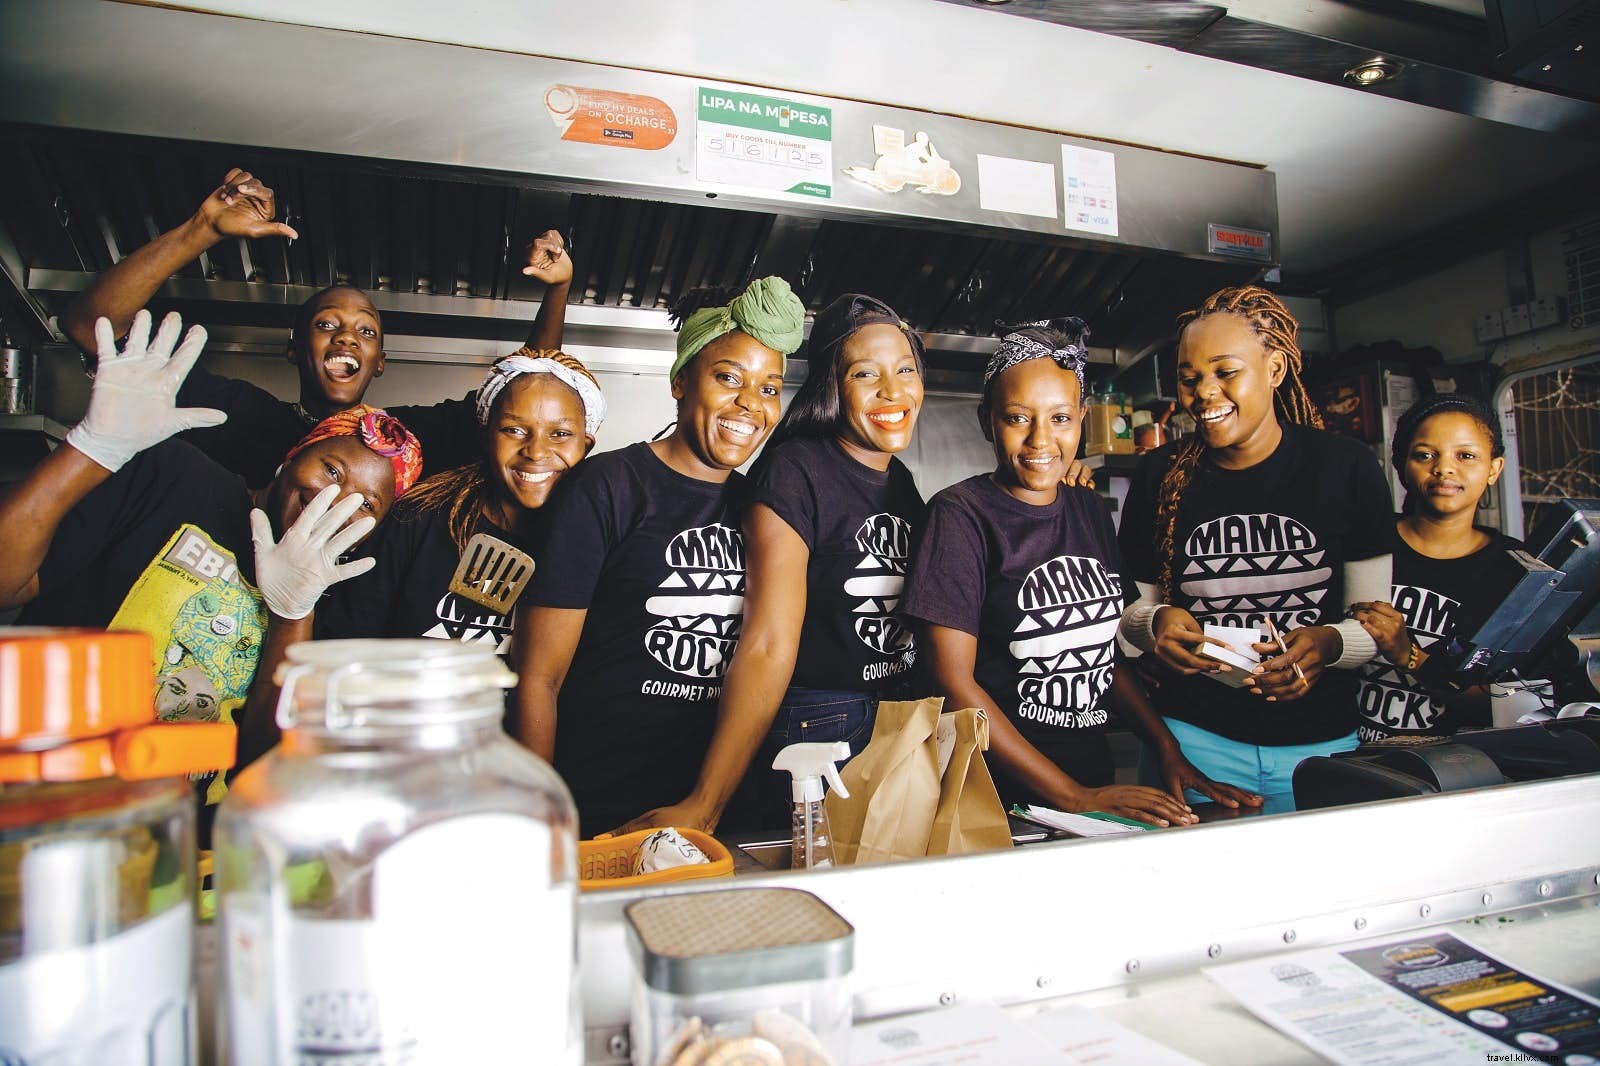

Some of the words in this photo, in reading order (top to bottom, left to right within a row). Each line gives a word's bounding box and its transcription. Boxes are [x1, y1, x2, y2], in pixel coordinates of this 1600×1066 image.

[702, 95, 736, 111] LIPA
[739, 100, 762, 115] NA
[588, 110, 602, 118] ON
[605, 113, 667, 130] OCHARGE
[740, 134, 764, 143] GOODS
[778, 140, 807, 149] NUMBER
[1190, 514, 1313, 556] MAMA
[641, 679, 705, 702] GOURMET
[1020, 664, 1113, 714] ROCKS
